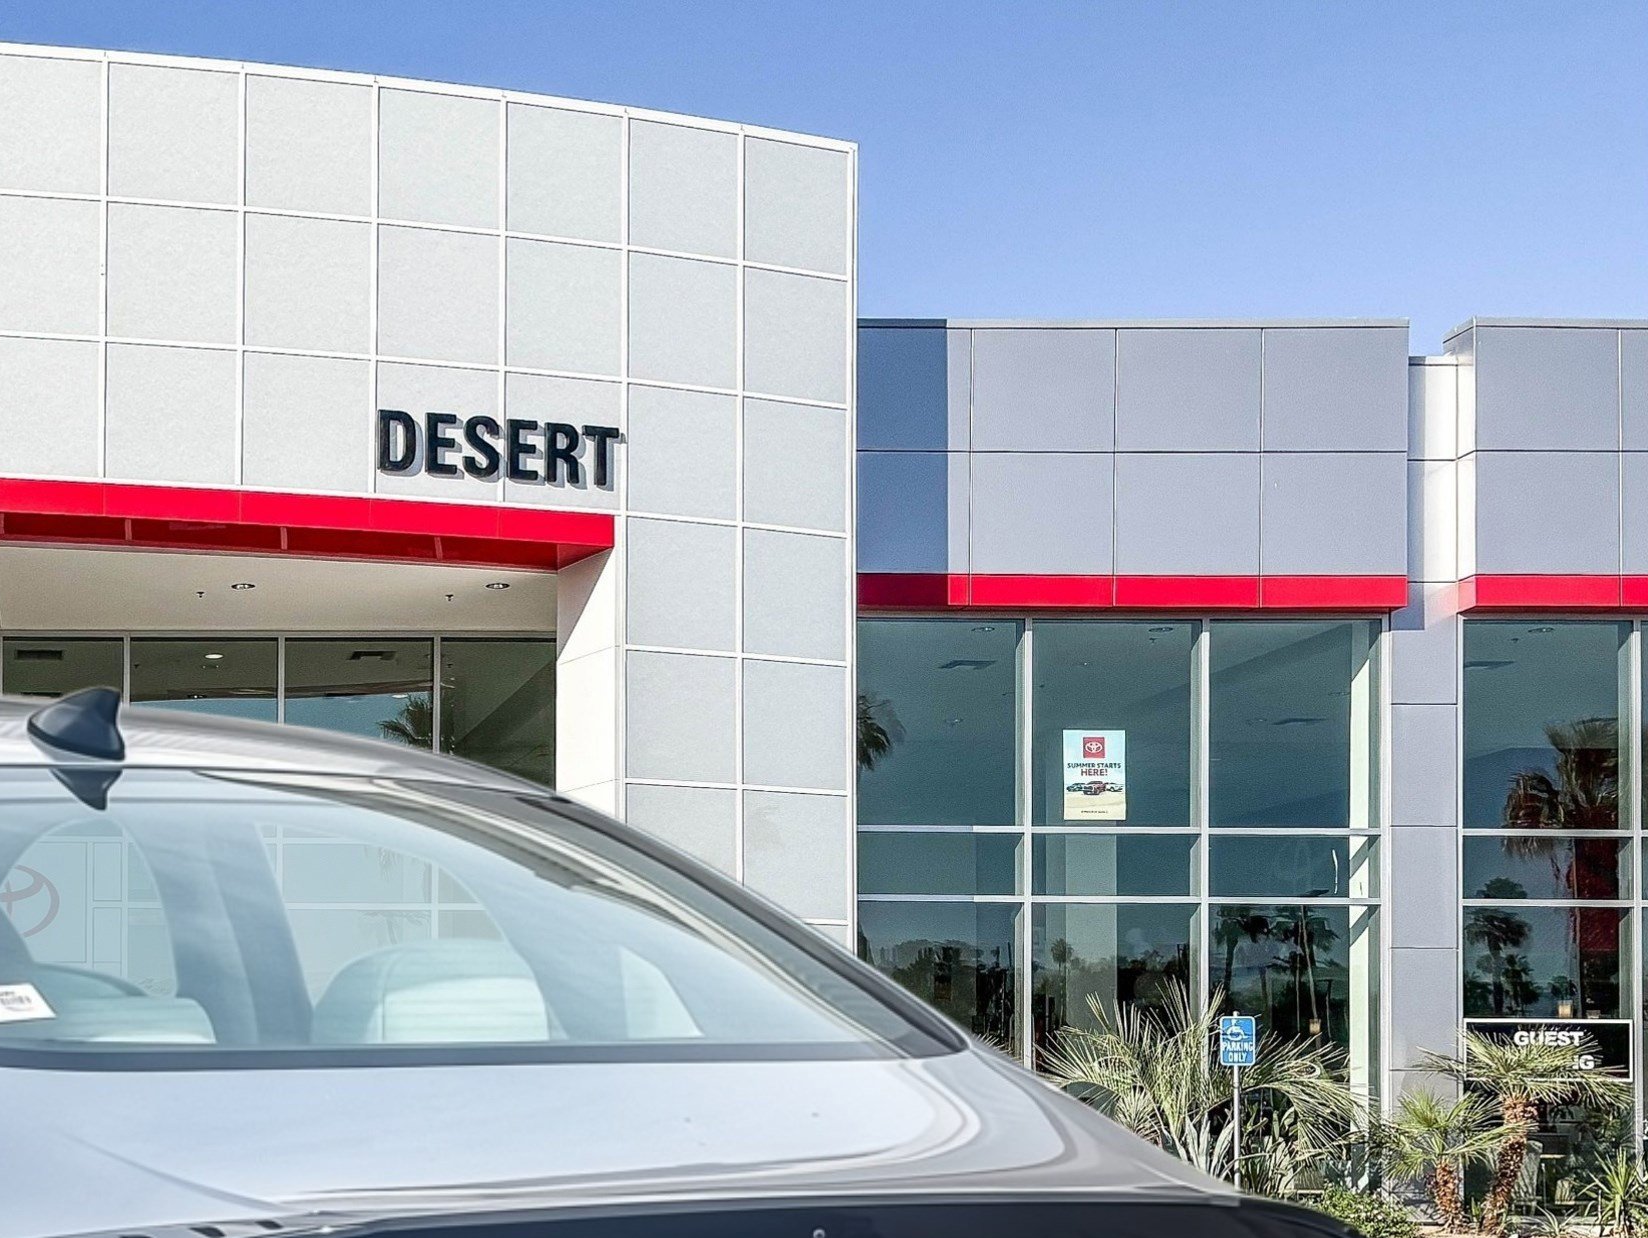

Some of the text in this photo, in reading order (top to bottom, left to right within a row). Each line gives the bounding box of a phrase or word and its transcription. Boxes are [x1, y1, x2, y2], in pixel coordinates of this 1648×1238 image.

[377, 408, 622, 487] DESERT
[1080, 769, 1108, 777] HERE!
[1513, 1030, 1584, 1046] GUEST
[1221, 1041, 1254, 1051] PARKING
[1228, 1052, 1247, 1062] ONLY
